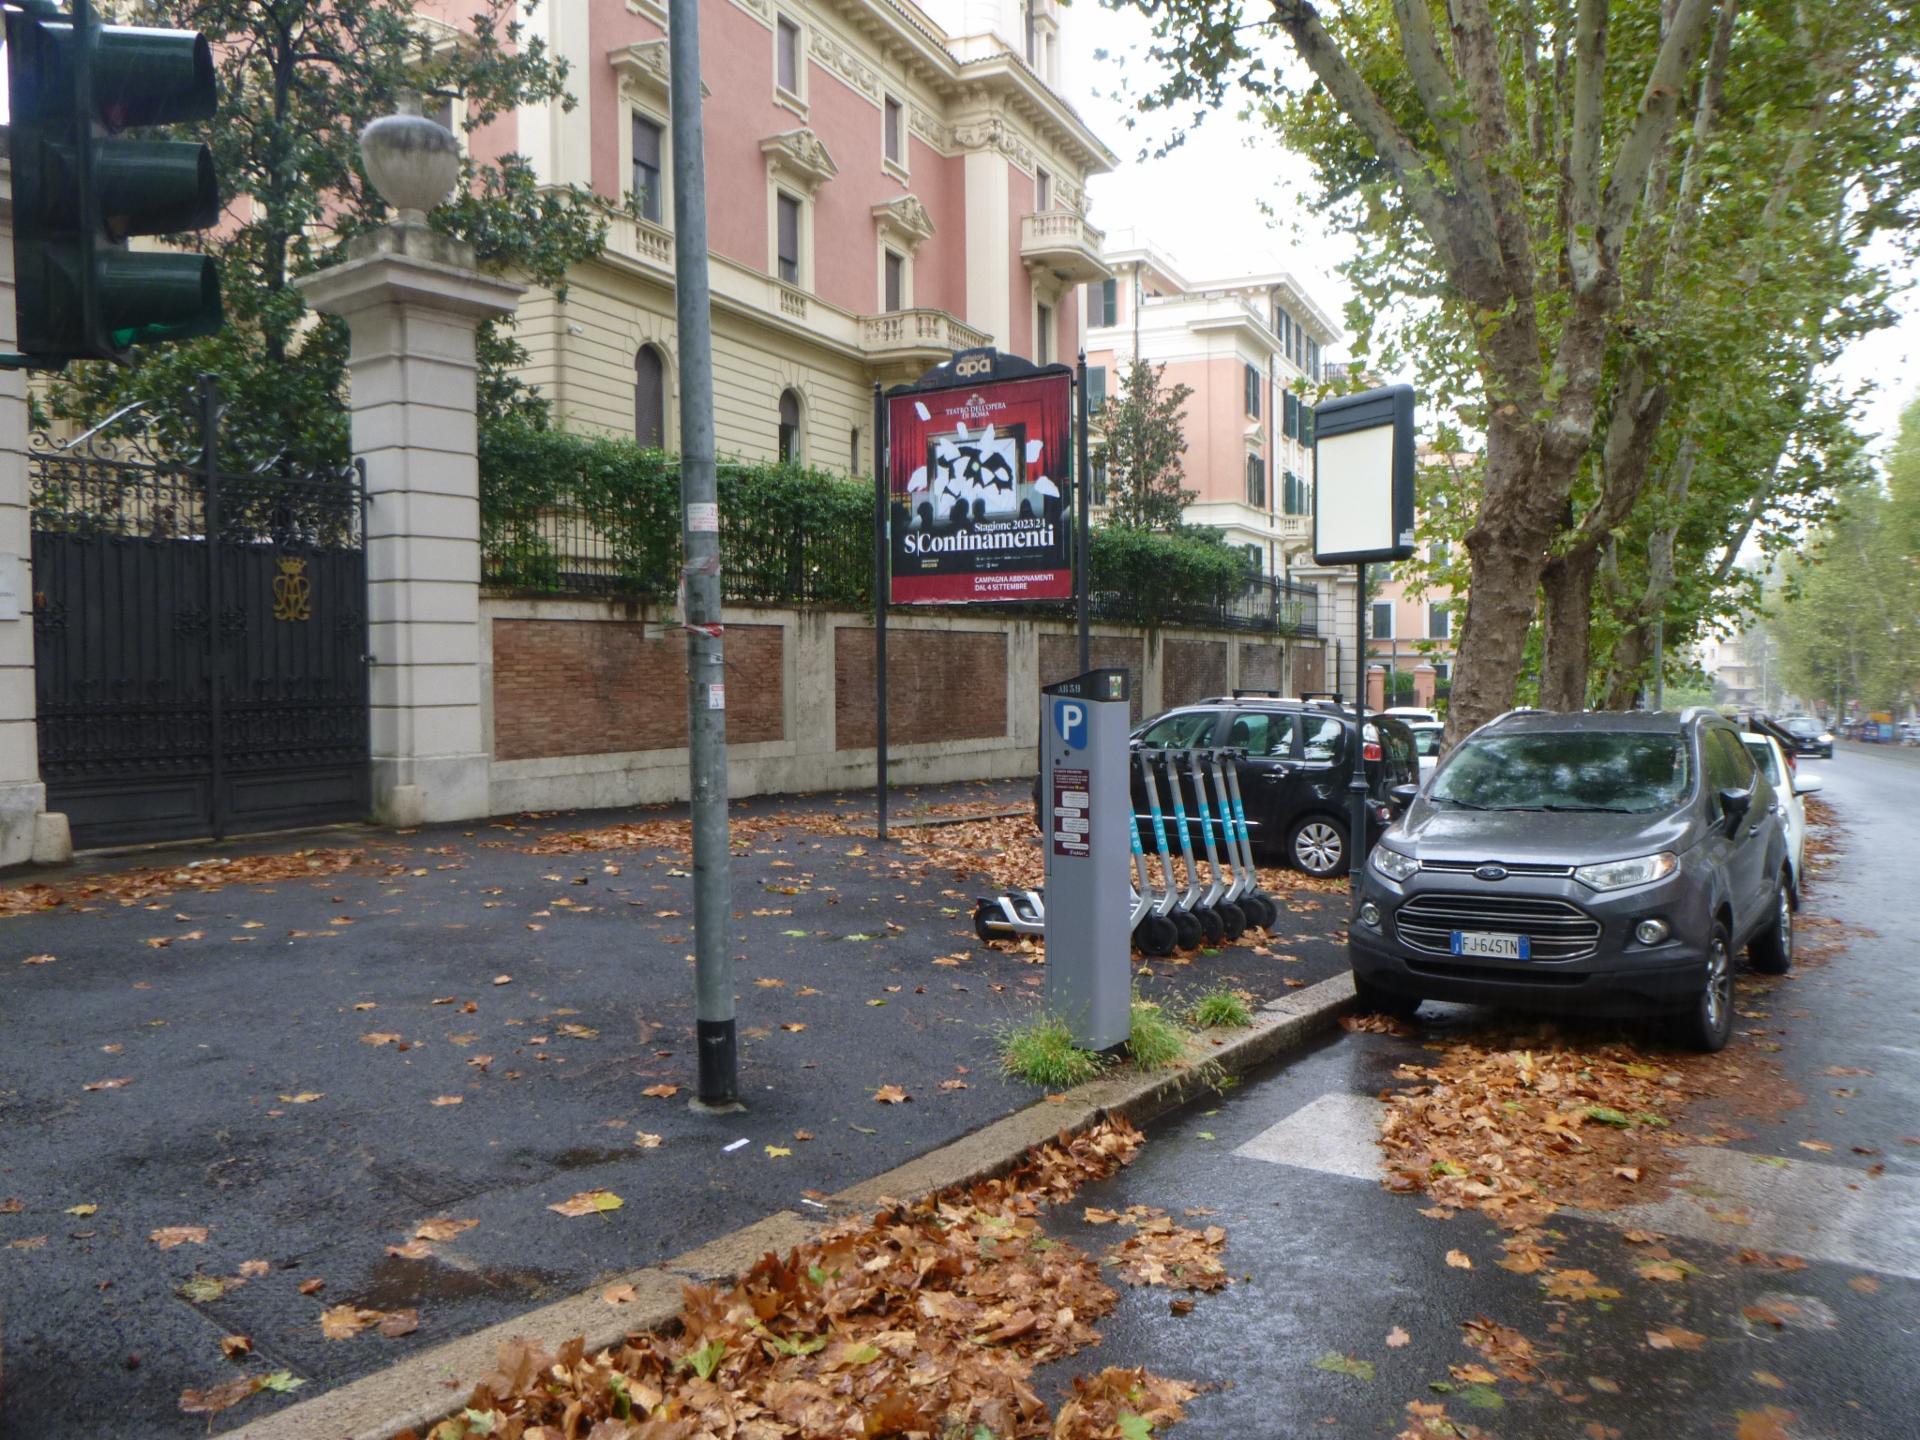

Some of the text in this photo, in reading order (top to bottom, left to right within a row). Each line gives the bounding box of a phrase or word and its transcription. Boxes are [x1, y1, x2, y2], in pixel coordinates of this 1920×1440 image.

[956, 358, 991, 377] apa
[945, 402, 1006, 416] TEATRO DELL'OPERA
[971, 410, 990, 419] ROMA
[974, 521, 1011, 533] Stagione
[974, 573, 1054, 584] CAMPAGNA ABBONAMENTI
[974, 584, 987, 592] DAL
[992, 583, 1028, 591] SETTEMBRE
[1063, 705, 1083, 740] P
